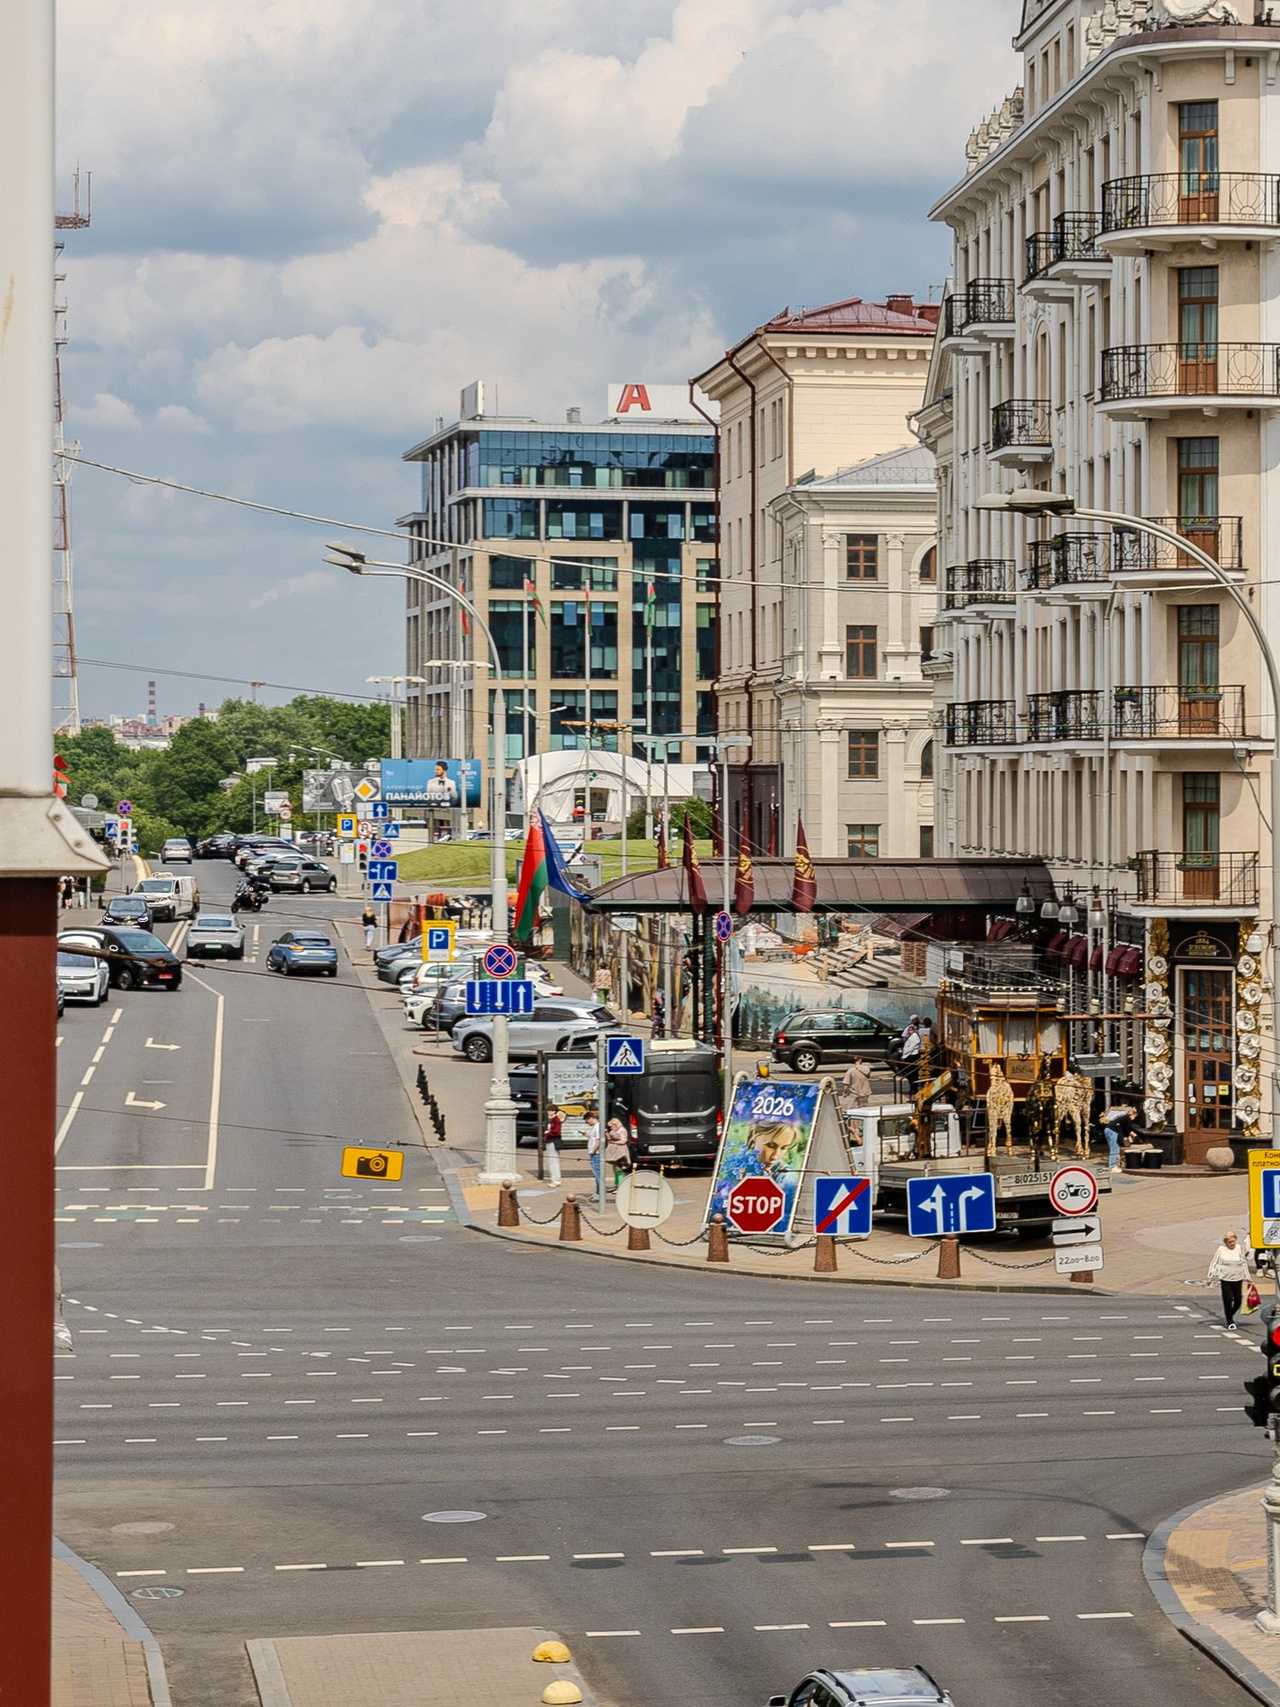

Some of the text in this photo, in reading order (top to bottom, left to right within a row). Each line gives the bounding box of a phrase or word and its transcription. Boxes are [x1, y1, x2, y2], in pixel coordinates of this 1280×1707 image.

[385, 791, 451, 801] ПАНАЙОТОВ
[343, 820, 351, 829] P
[432, 931, 445, 948] P
[752, 1096, 794, 1116] 2026
[731, 1195, 782, 1214] STOP
